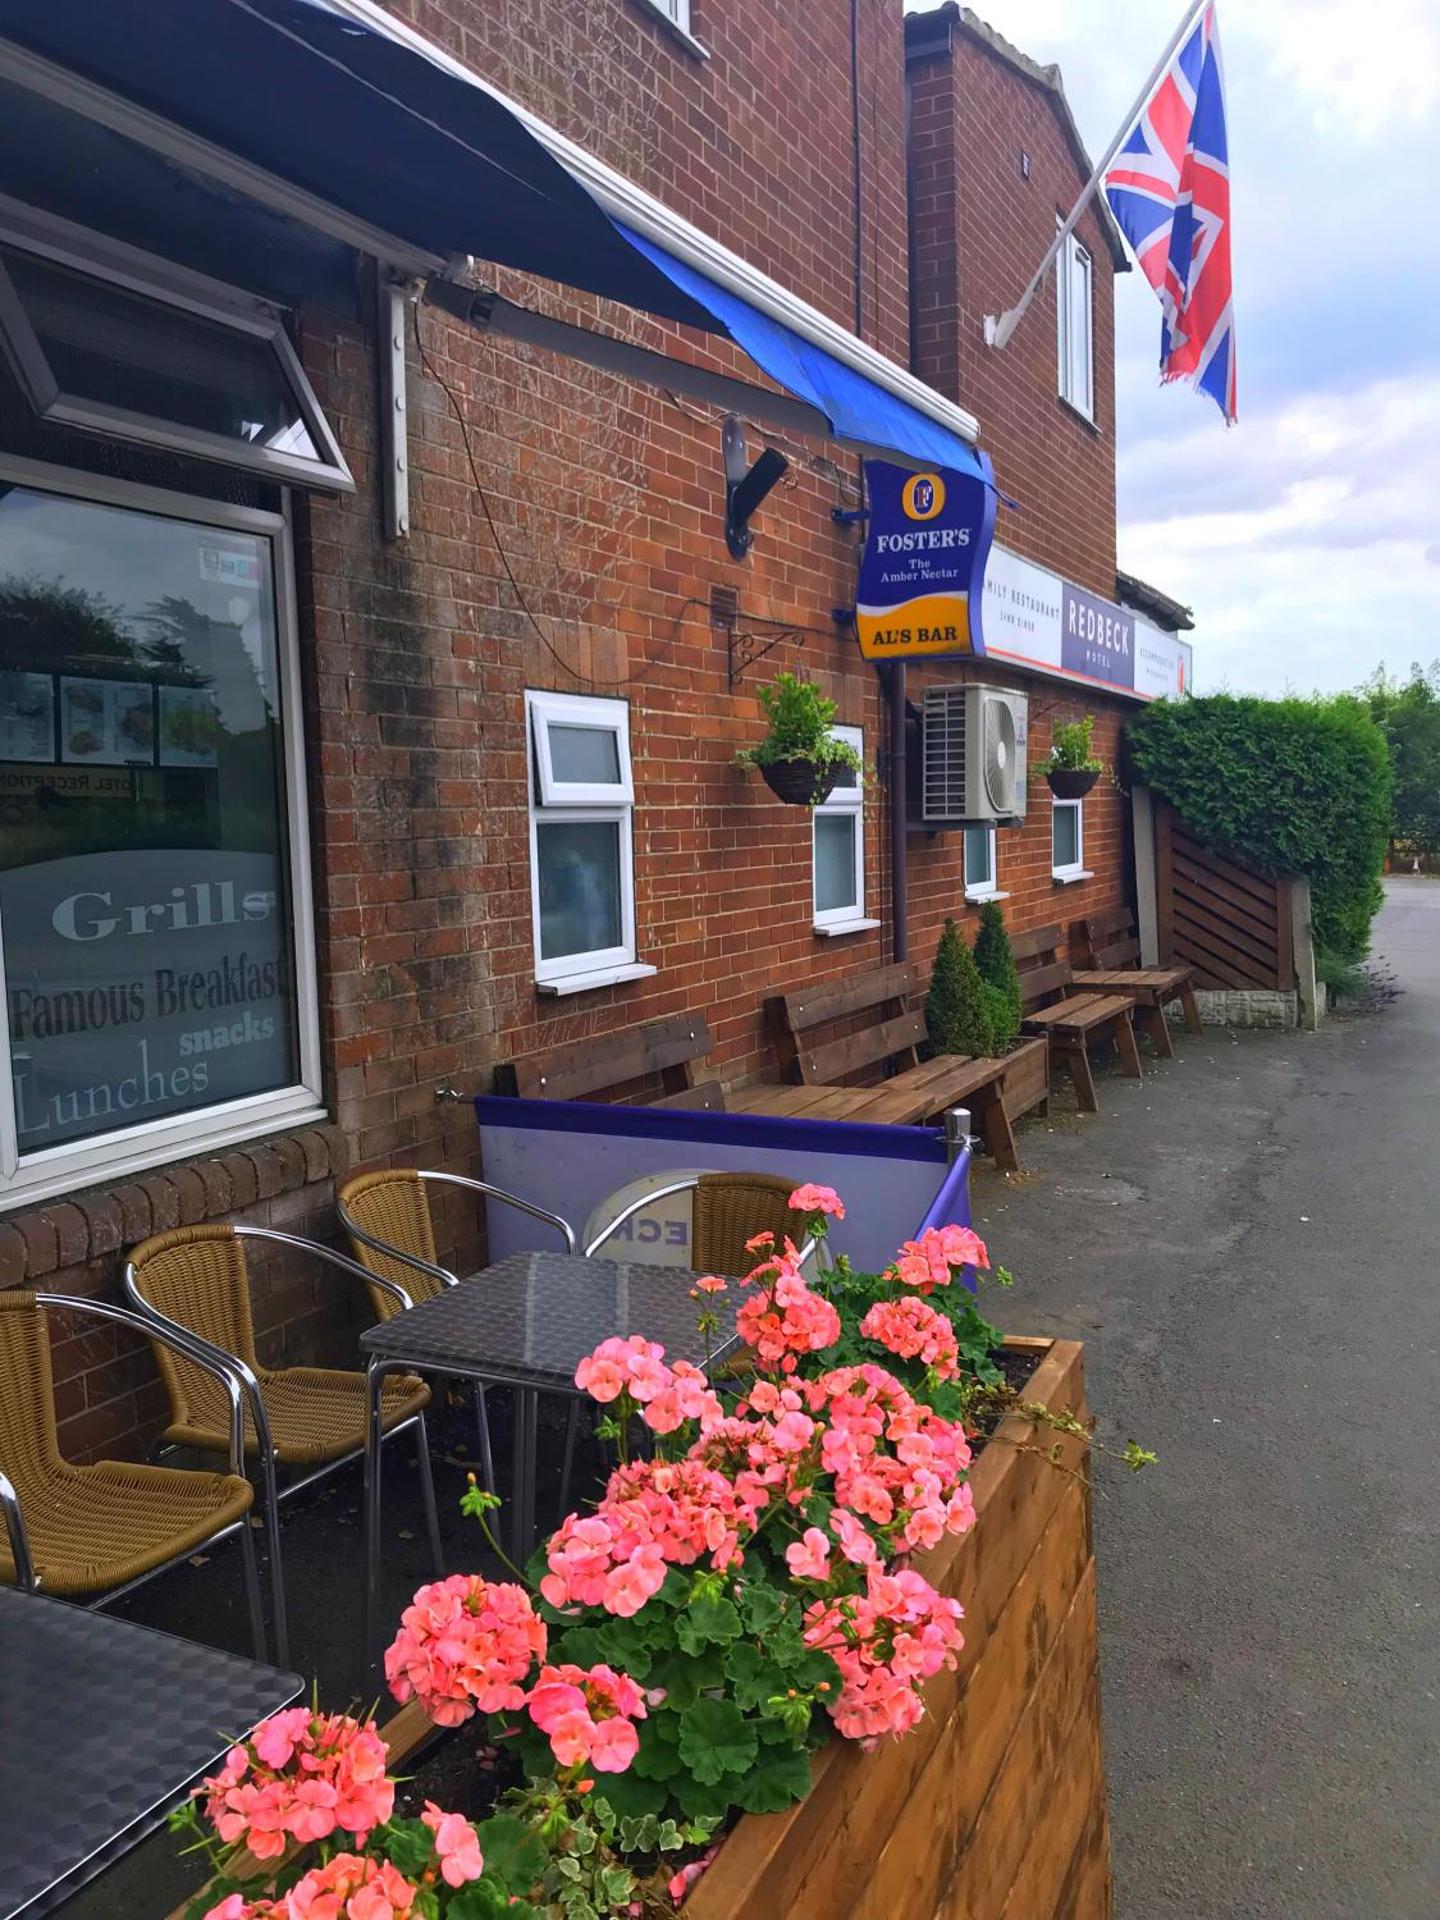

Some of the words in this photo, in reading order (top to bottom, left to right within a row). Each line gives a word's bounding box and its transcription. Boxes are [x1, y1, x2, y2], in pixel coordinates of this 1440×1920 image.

[876, 528, 970, 554] FOSTER'S
[880, 571, 918, 583] Amber
[921, 568, 959, 581] Nectar
[908, 558, 931, 570] The
[984, 578, 1007, 600] MILY
[1011, 588, 1060, 622] RESTAURANT
[873, 629, 911, 646] AL'S
[917, 625, 959, 642] BAR
[1068, 598, 1129, 657] REDBECK
[51, 880, 276, 942] Grills
[10, 979, 145, 1041] Famous
[178, 1010, 275, 1057] snacks
[13, 1038, 209, 1134] Lunches
